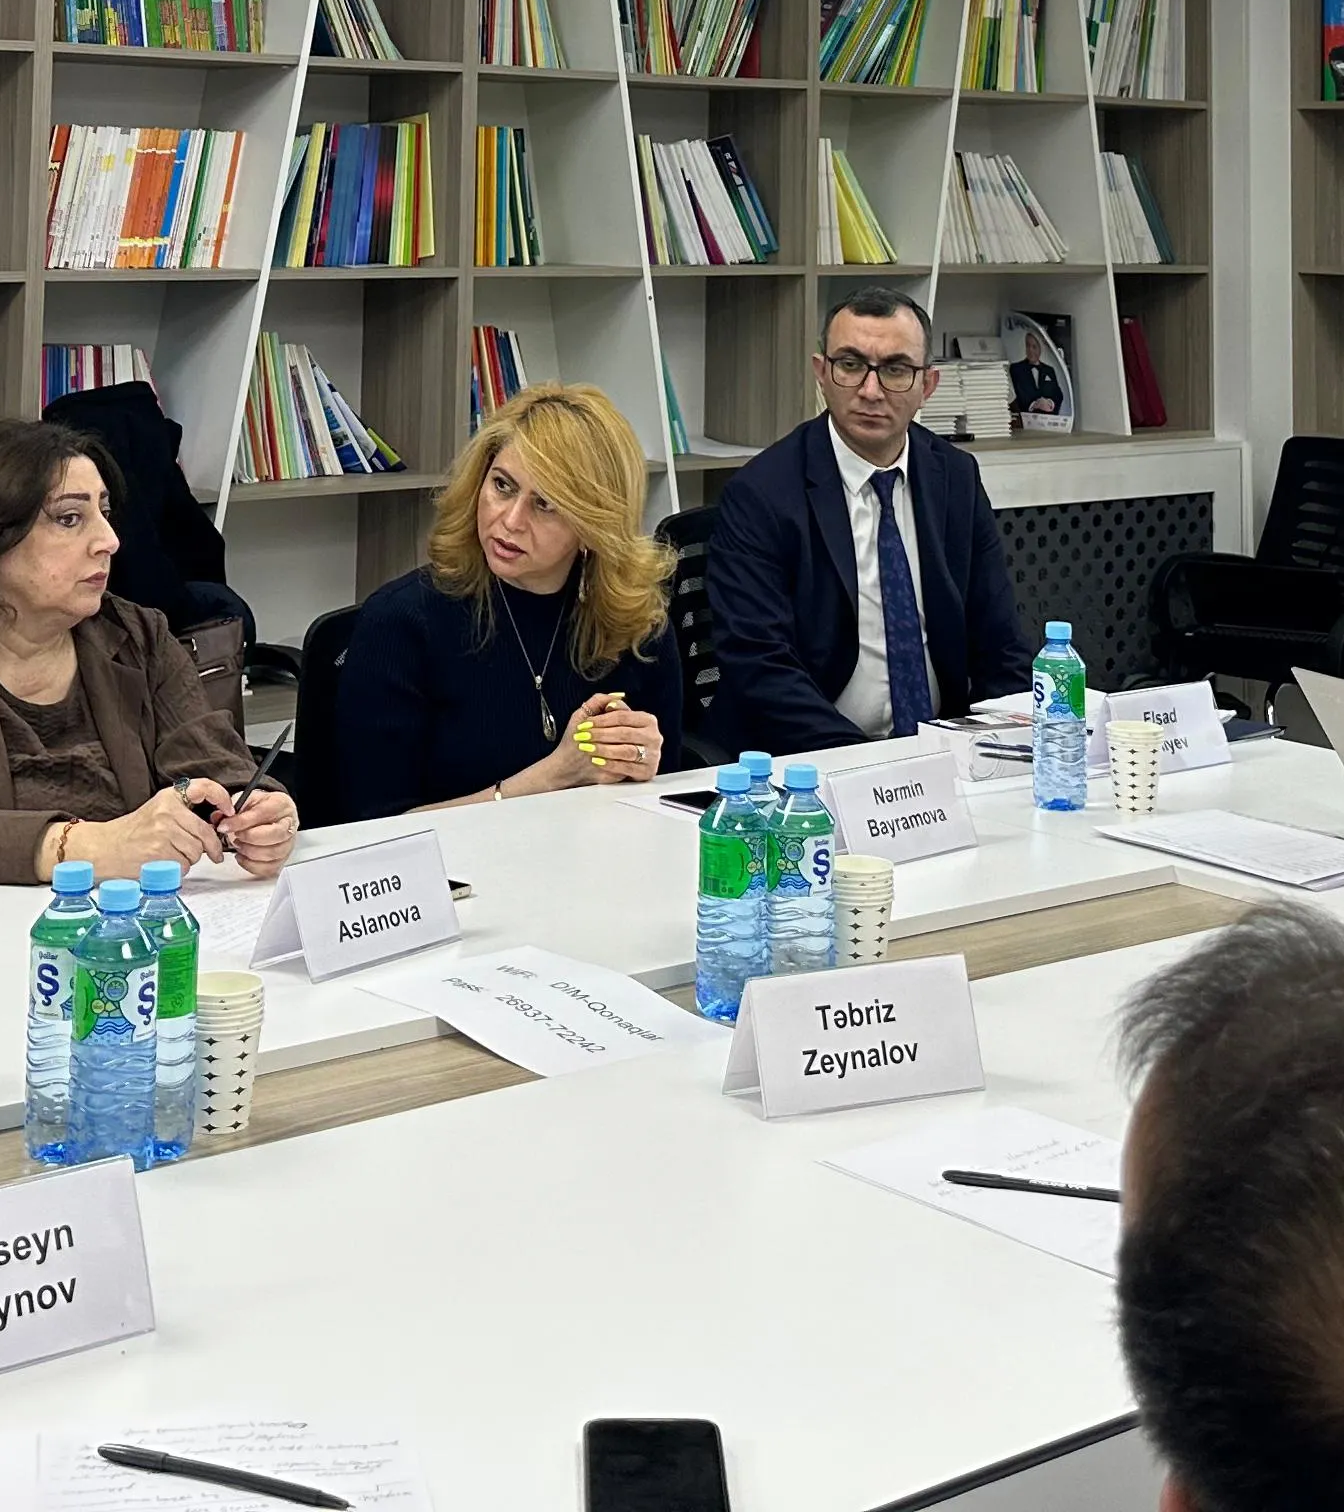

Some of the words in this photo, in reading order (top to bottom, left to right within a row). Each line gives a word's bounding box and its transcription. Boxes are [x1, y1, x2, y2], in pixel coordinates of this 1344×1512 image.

[872, 779, 925, 807] Nərmin
[867, 806, 948, 838] Bayramova
[338, 874, 403, 905] Təranə
[338, 904, 423, 943] Aslanova
[815, 999, 897, 1031] Təbriz
[802, 1040, 919, 1079] Zeynalov
